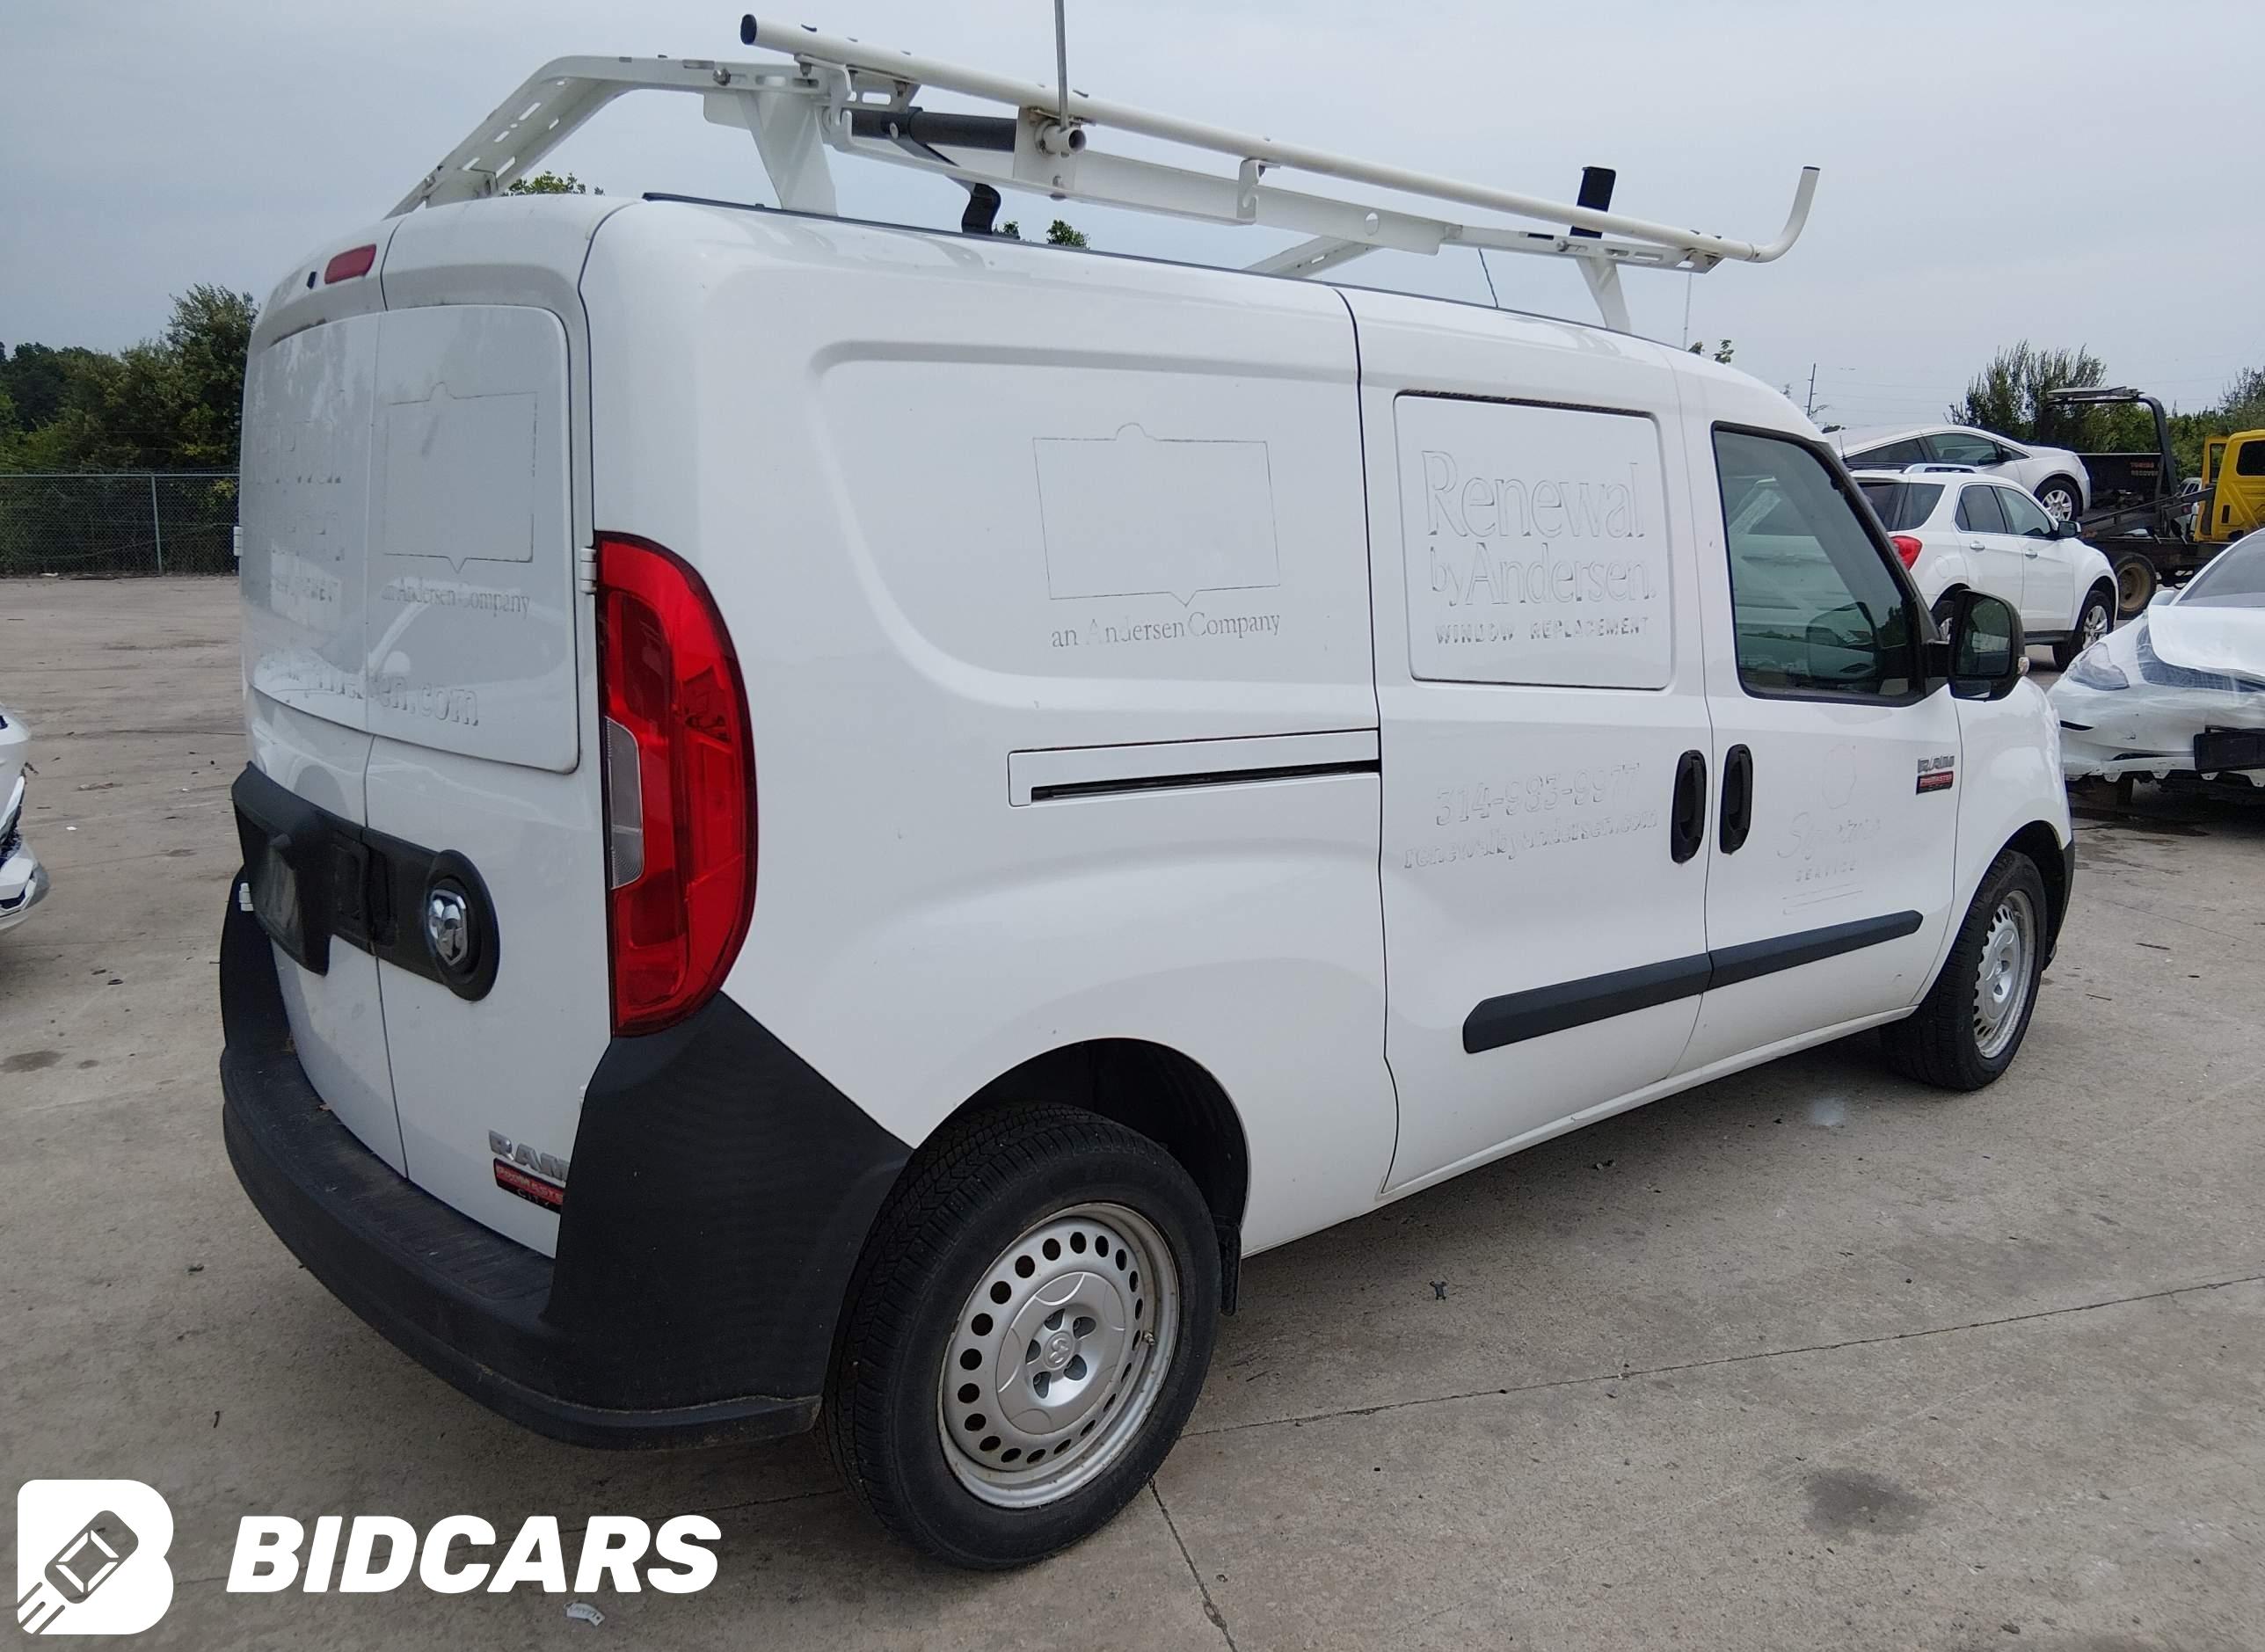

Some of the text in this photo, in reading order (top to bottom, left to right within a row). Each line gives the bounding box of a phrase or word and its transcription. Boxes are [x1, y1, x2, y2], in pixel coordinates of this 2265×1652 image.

[1421, 450, 1645, 537] Renewal
[397, 577, 455, 606] Andersen
[1430, 546, 1462, 607] by
[1052, 611, 1280, 647] an Andersen Company
[1918, 755, 1955, 774] RAM
